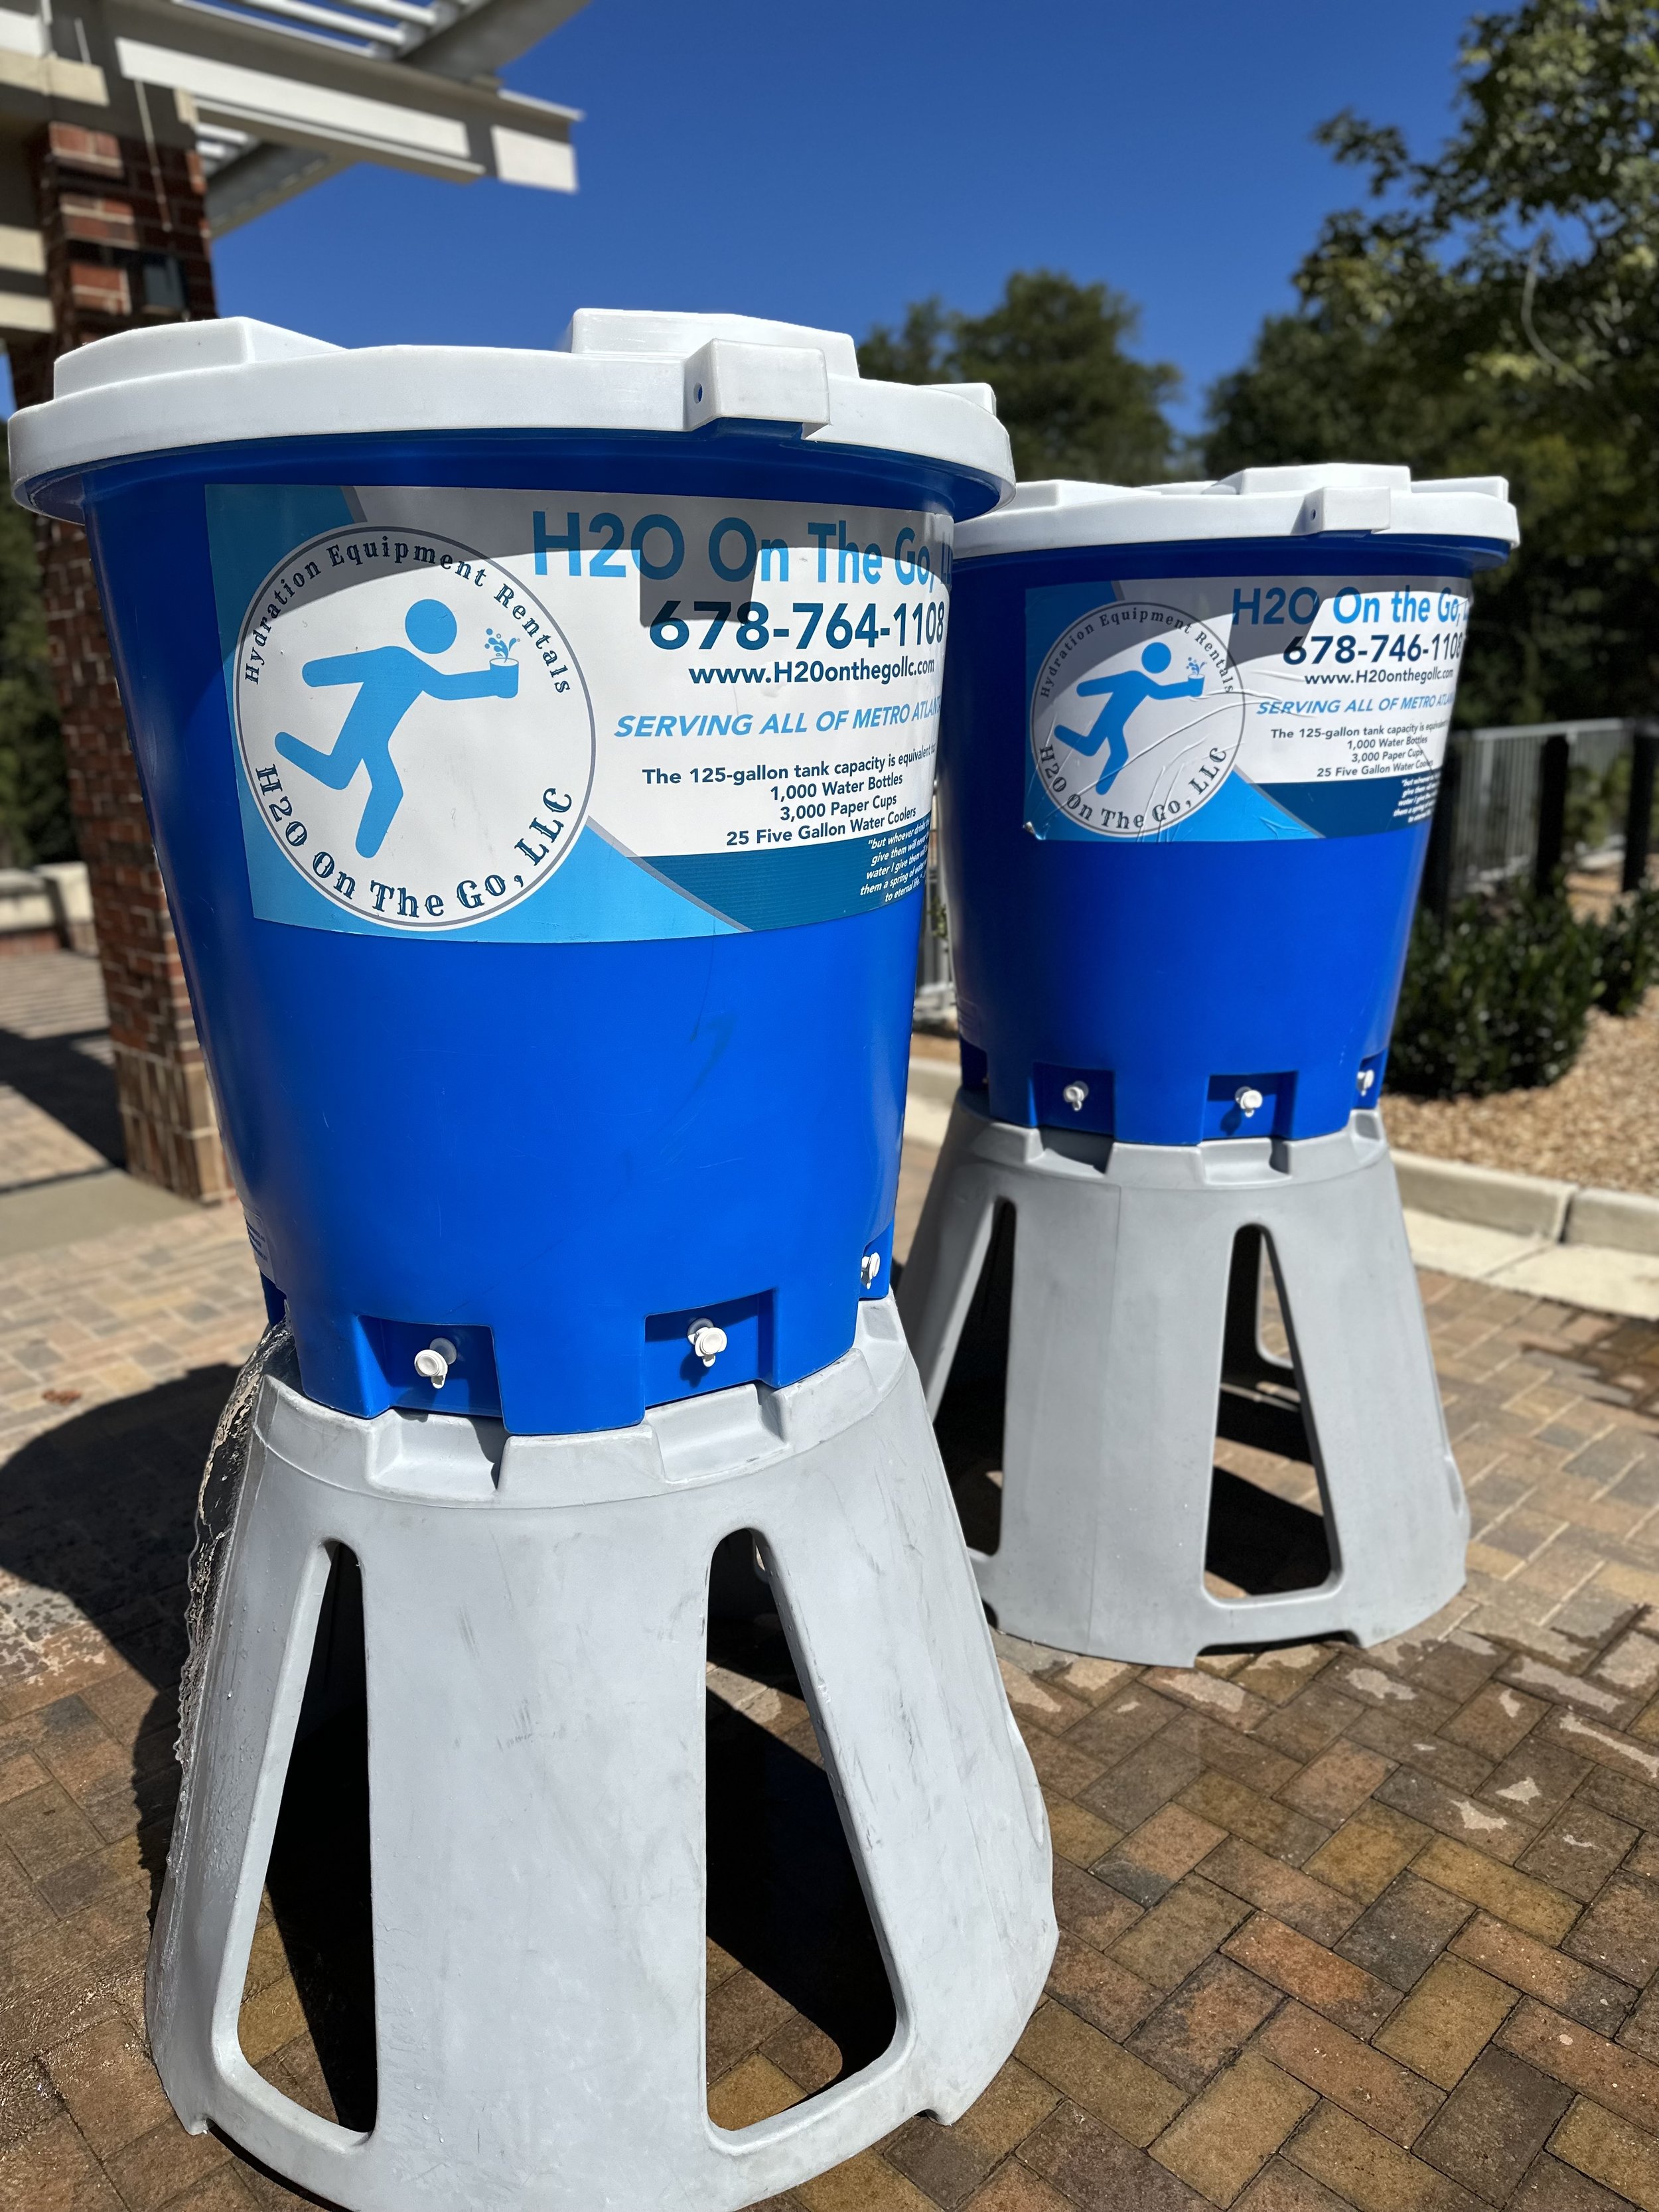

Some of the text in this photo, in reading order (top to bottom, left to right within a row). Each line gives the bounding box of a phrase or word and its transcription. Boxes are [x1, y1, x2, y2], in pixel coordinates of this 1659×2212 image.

[532, 510, 685, 581] H2O
[708, 517, 790, 583] On
[808, 522, 882, 585] The
[895, 526, 934, 593] Go,
[244, 536, 571, 694] Hydration Equipment Rentals
[1232, 587, 1321, 626] H2O
[1333, 587, 1380, 625] On
[1392, 585, 1431, 623] the
[1438, 587, 1461, 627] Go,
[649, 600, 945, 650] 678-764-1108
[1039, 607, 1234, 698] Hydration Equipment Rentals
[1283, 631, 1463, 665] 678-746-1108
[614, 713, 753, 737] SERVING
[758, 710, 808, 735] ALL
[816, 709, 849, 731] OF
[852, 703, 910, 729] METRO
[1256, 700, 1340, 715] SERVING
[1344, 698, 1373, 713] ALL
[1378, 698, 1400, 711] OF
[1400, 695, 1437, 710] METRO
[1271, 729, 1294, 739] The
[1299, 727, 1360, 740] 125-gallon
[1363, 725, 1384, 736] tank
[1387, 723, 1418, 735] capacity
[1419, 721, 1425, 731] is
[1347, 735, 1428, 750] 1,000 Water Bottles
[642, 768, 682, 784] The
[689, 764, 789, 786] 125-gallon
[794, 761, 830, 778] tank
[834, 756, 885, 776] capacity
[888, 753, 896, 767] is
[898, 745, 930, 767] equivalent
[1317, 768, 1332, 777] 25
[1336, 767, 1358, 776] Five
[1361, 763, 1390, 774] Gallon
[1393, 761, 1413, 772] Water
[1351, 748, 1423, 763] 3,000 Paper Cups
[770, 772, 902, 802] 1,000 Water Bottles
[1066, 793, 1094, 822] On
[1100, 807, 1145, 830] The
[1188, 747, 1228, 796] LLC
[780, 795, 897, 822] 3,000 Paper Cups
[727, 830, 749, 846] 25
[757, 828, 792, 844] Five
[798, 822, 845, 840] Gallon
[850, 816, 885, 833] Water
[888, 806, 916, 824] Coolers
[888, 829, 914, 845] whoever
[312, 851, 357, 899] On
[369, 879, 445, 918] The
[455, 873, 525, 910] Go,
[514, 787, 573, 867] LLC
[871, 851, 889, 867] give
[891, 845, 907, 858] them
[860, 883, 883, 896] them
[883, 881, 889, 889] a
[889, 873, 908, 889] spring
[866, 865, 891, 880] water
[894, 859, 908, 874] give
[885, 893, 893, 903] to
